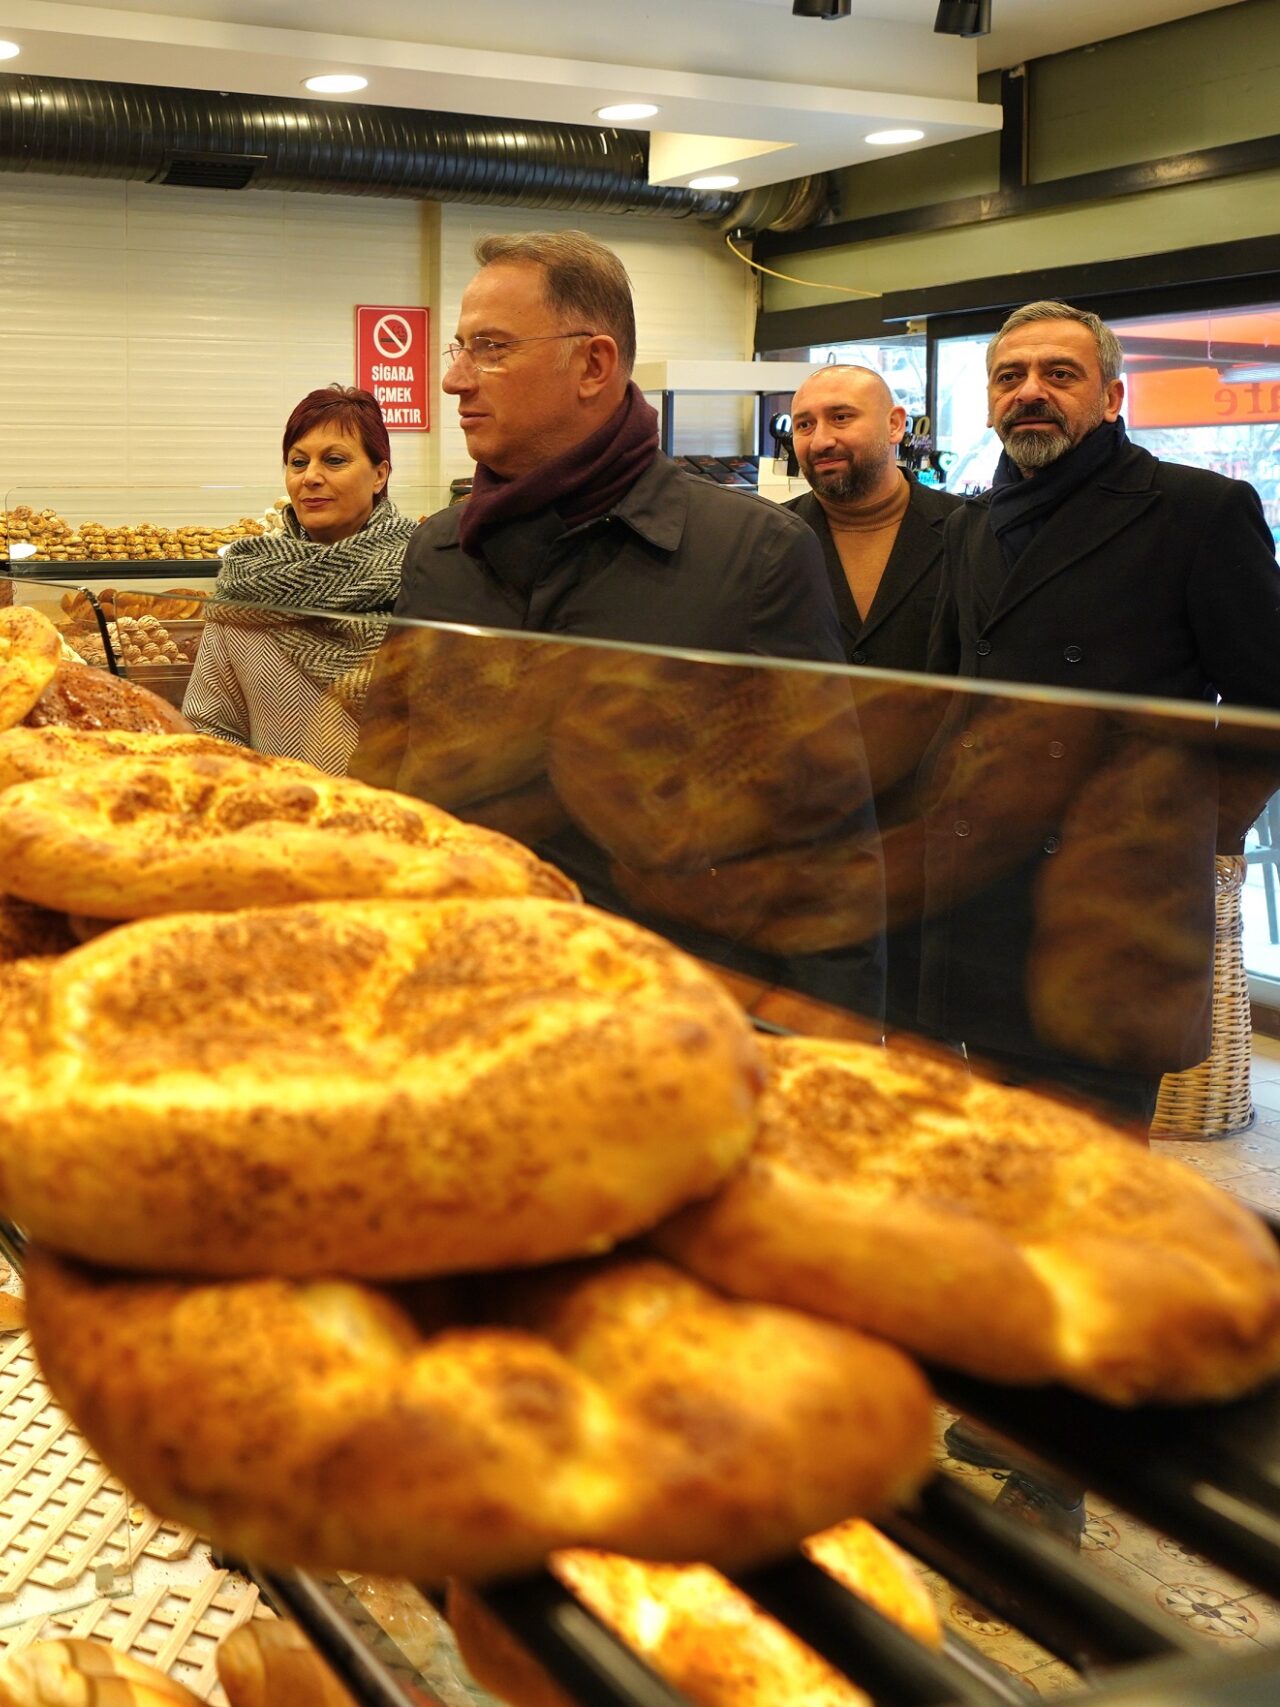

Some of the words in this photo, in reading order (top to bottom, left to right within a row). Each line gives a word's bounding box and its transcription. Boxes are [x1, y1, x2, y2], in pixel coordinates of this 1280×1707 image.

[371, 363, 414, 382] SİGARA
[373, 384, 412, 405] İÇMEK
[382, 408, 421, 424] SAKTIR
